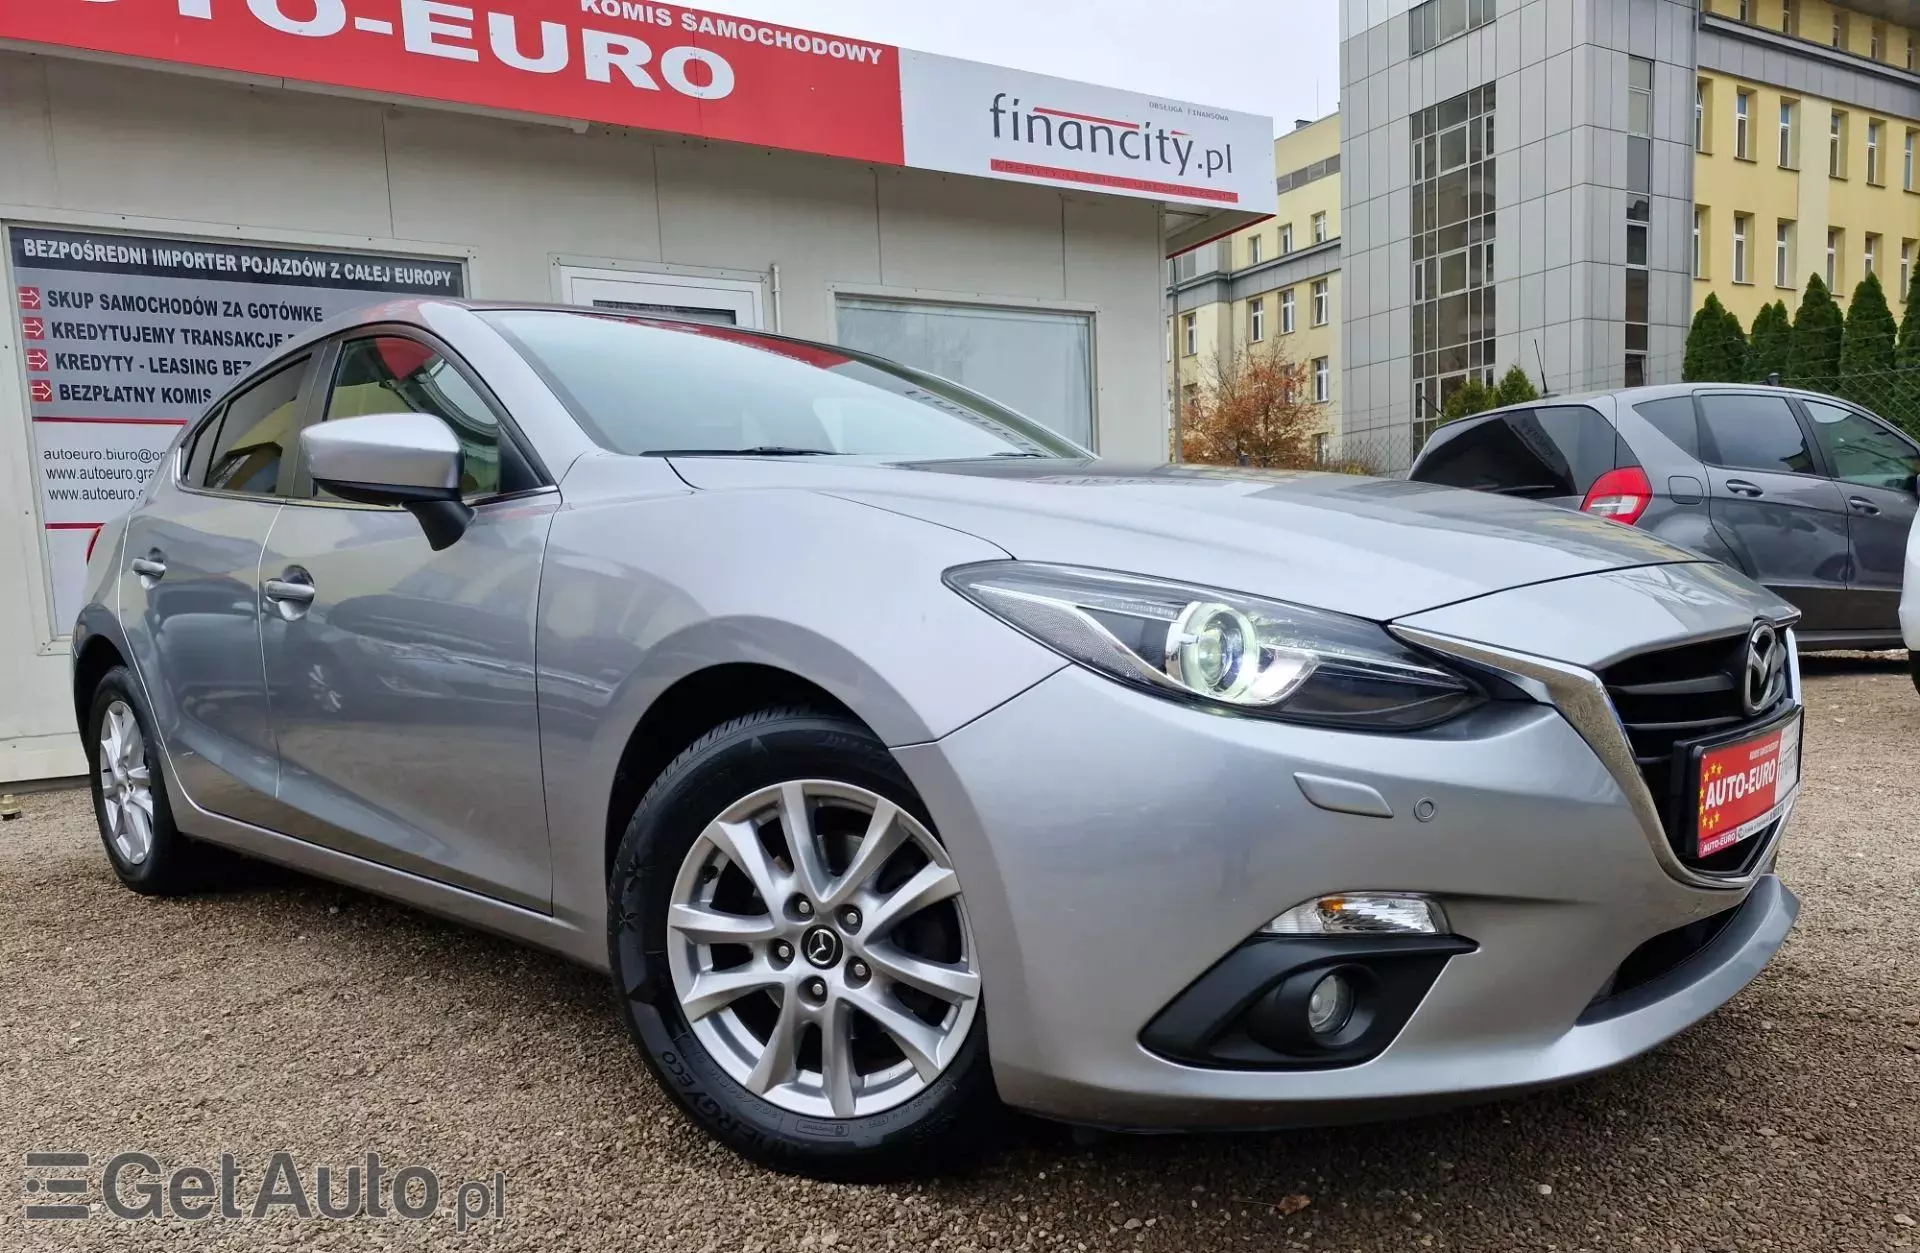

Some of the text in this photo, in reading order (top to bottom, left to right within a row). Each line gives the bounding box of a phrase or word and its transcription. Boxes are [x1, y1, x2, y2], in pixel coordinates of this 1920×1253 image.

[581, 0, 882, 65] KOMIS SAMOCHODOWY
[989, 93, 1232, 178] financity.pl
[23, 238, 451, 287] BEZPOŚREDNI IMPORTER POJAZDÓW Z CAŁEJ EUROPY
[48, 290, 94, 309] SKUP
[100, 293, 218, 317] SAMOCHODÓW
[223, 302, 244, 319] ZA
[51, 322, 283, 349] KREDYTUJEMY TRANSAKCJE
[55, 353, 134, 372] KREDYTY
[149, 357, 218, 376] LEASING
[59, 384, 212, 404] BEZPŁATNY KOMIS
[1706, 758, 1776, 810] AUTO-EURO
[1703, 832, 1736, 853] AUTO-EURO
[662, 1050, 696, 1087] ECO
